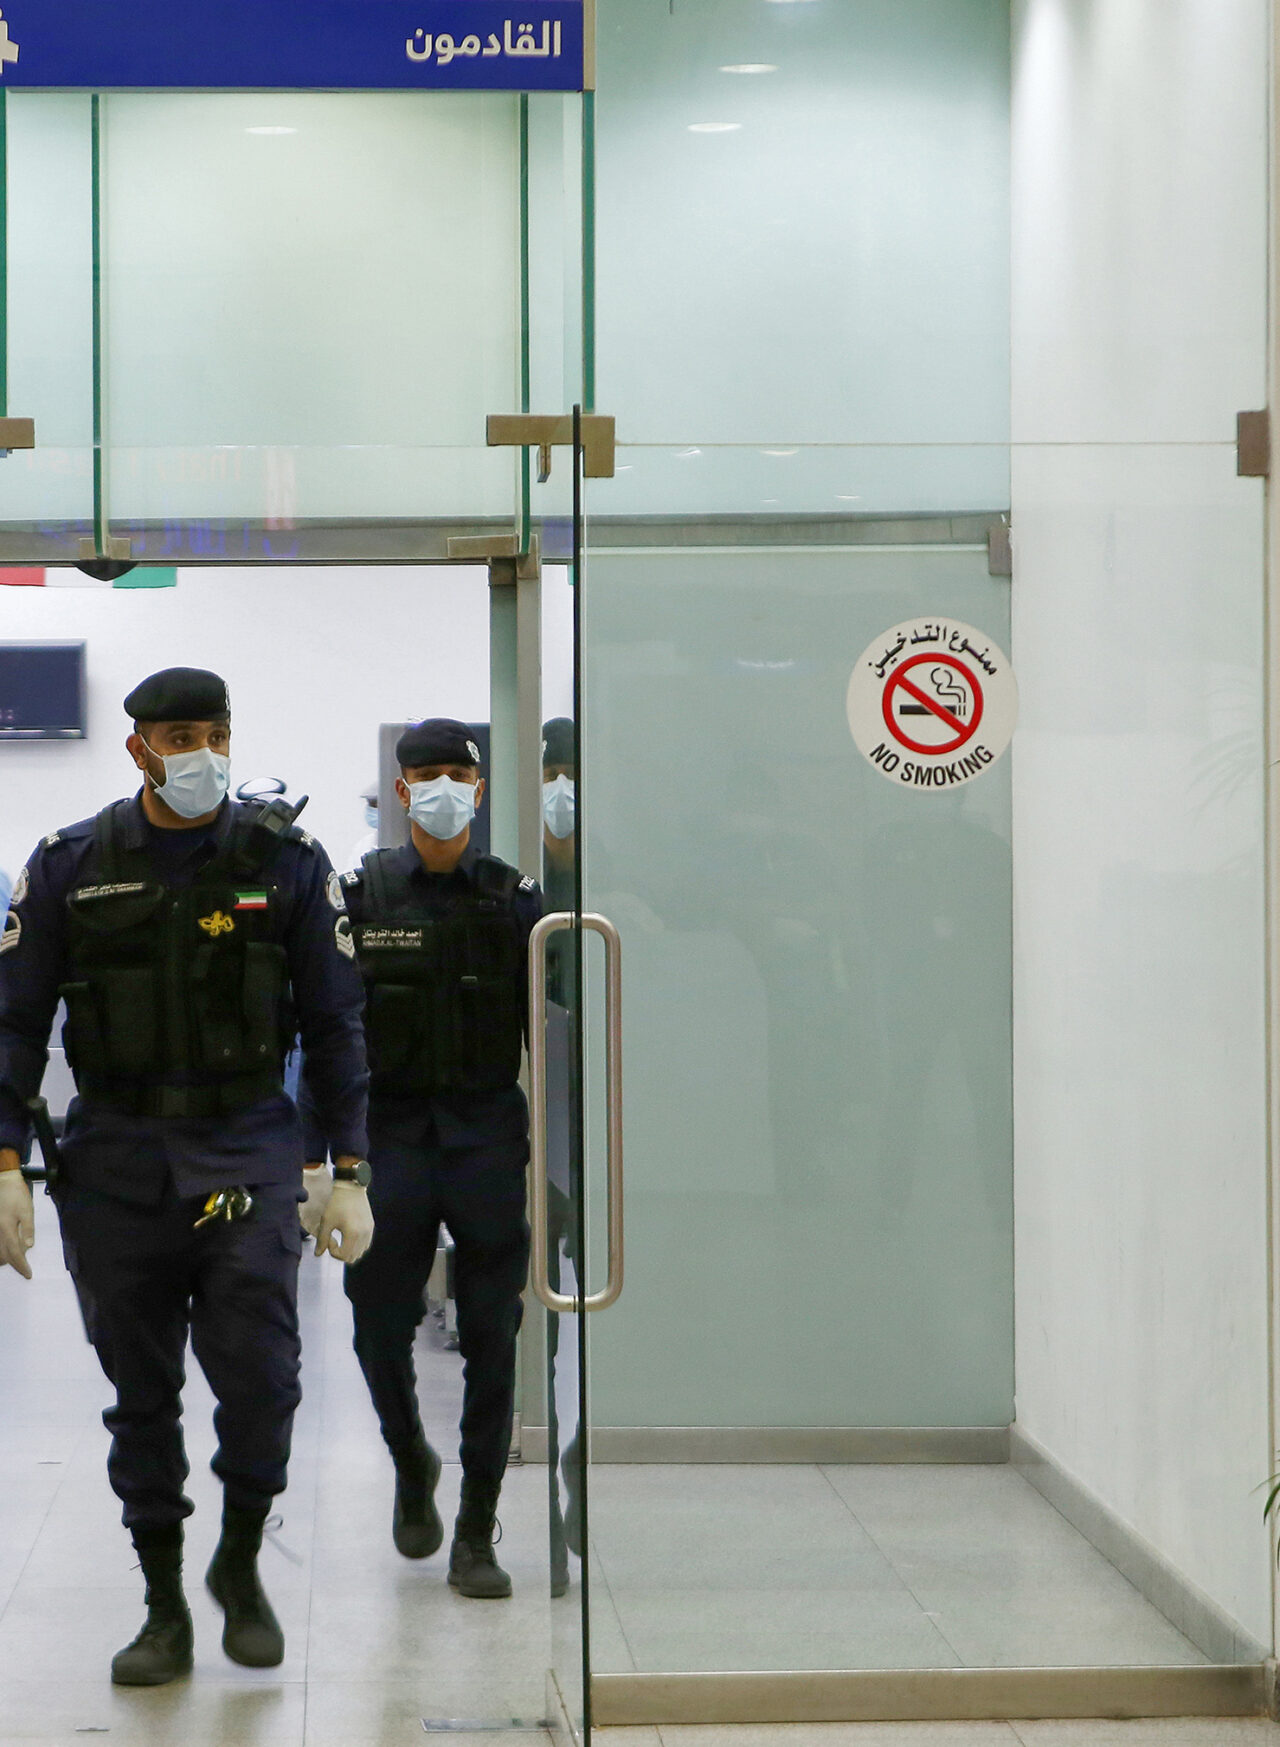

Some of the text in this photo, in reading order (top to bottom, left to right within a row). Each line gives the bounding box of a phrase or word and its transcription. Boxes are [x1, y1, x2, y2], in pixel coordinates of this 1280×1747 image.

[405, 19, 562, 66] القادمون
[868, 624, 997, 679] ممنوع التدخين
[869, 742, 995, 786] NO SMOKING
